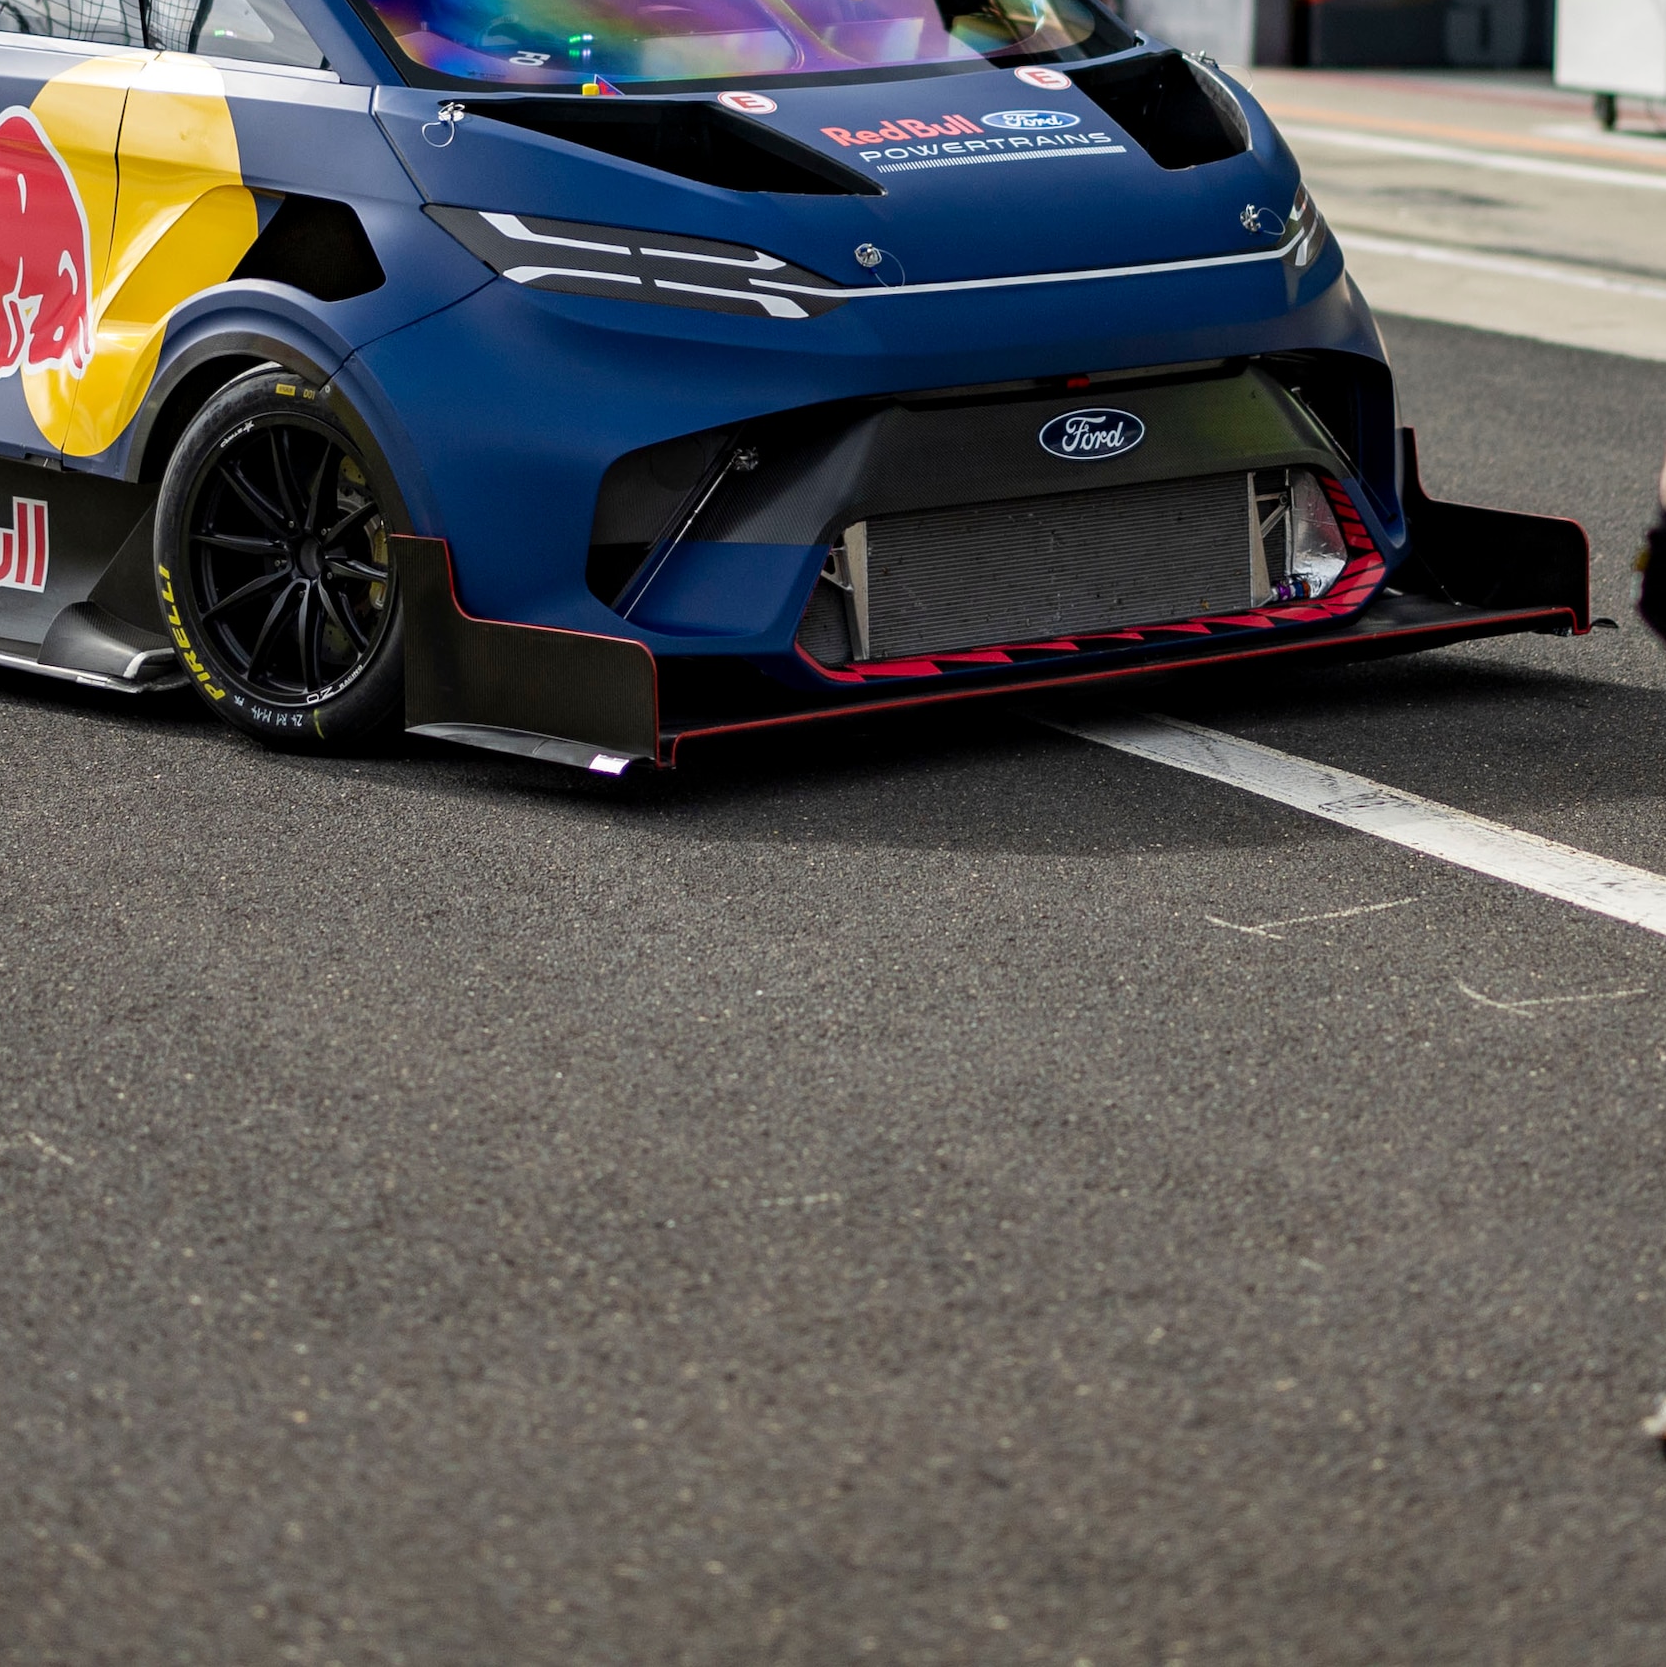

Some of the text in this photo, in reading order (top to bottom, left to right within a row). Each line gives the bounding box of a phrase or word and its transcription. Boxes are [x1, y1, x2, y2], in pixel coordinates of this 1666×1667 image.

[1002, 112, 1063, 128] Ford
[859, 132, 1112, 163] POWERTRAINS
[1062, 416, 1124, 452] Ford
[159, 564, 226, 700] PIRELLI
